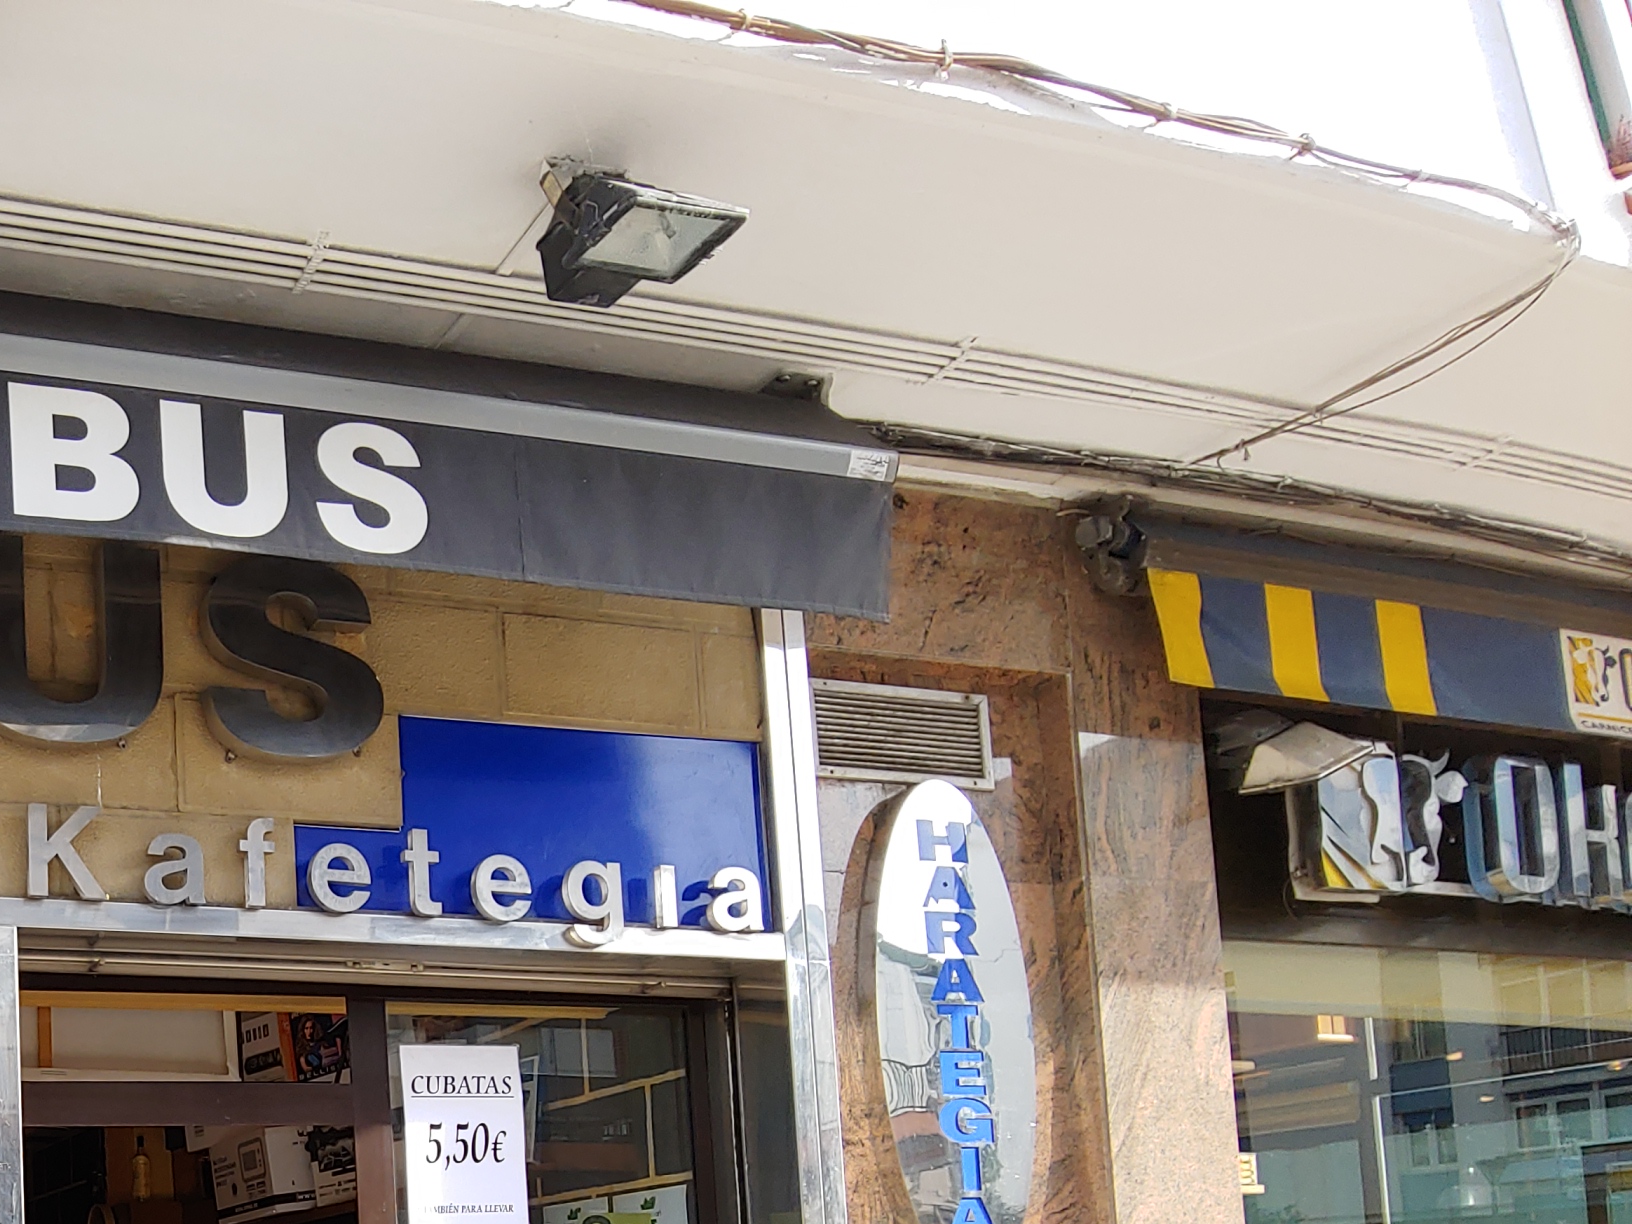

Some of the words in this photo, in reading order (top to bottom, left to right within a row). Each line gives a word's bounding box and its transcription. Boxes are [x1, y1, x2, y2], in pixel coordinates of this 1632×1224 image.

[8, 381, 429, 555] BUS
[410, 1075, 513, 1095] CUBATAS
[425, 1121, 508, 1171] 5,50€
[424, 1202, 460, 1214] MBIÉN
[461, 1204, 483, 1213] PARA
[484, 1204, 514, 1213] LLEVAR
